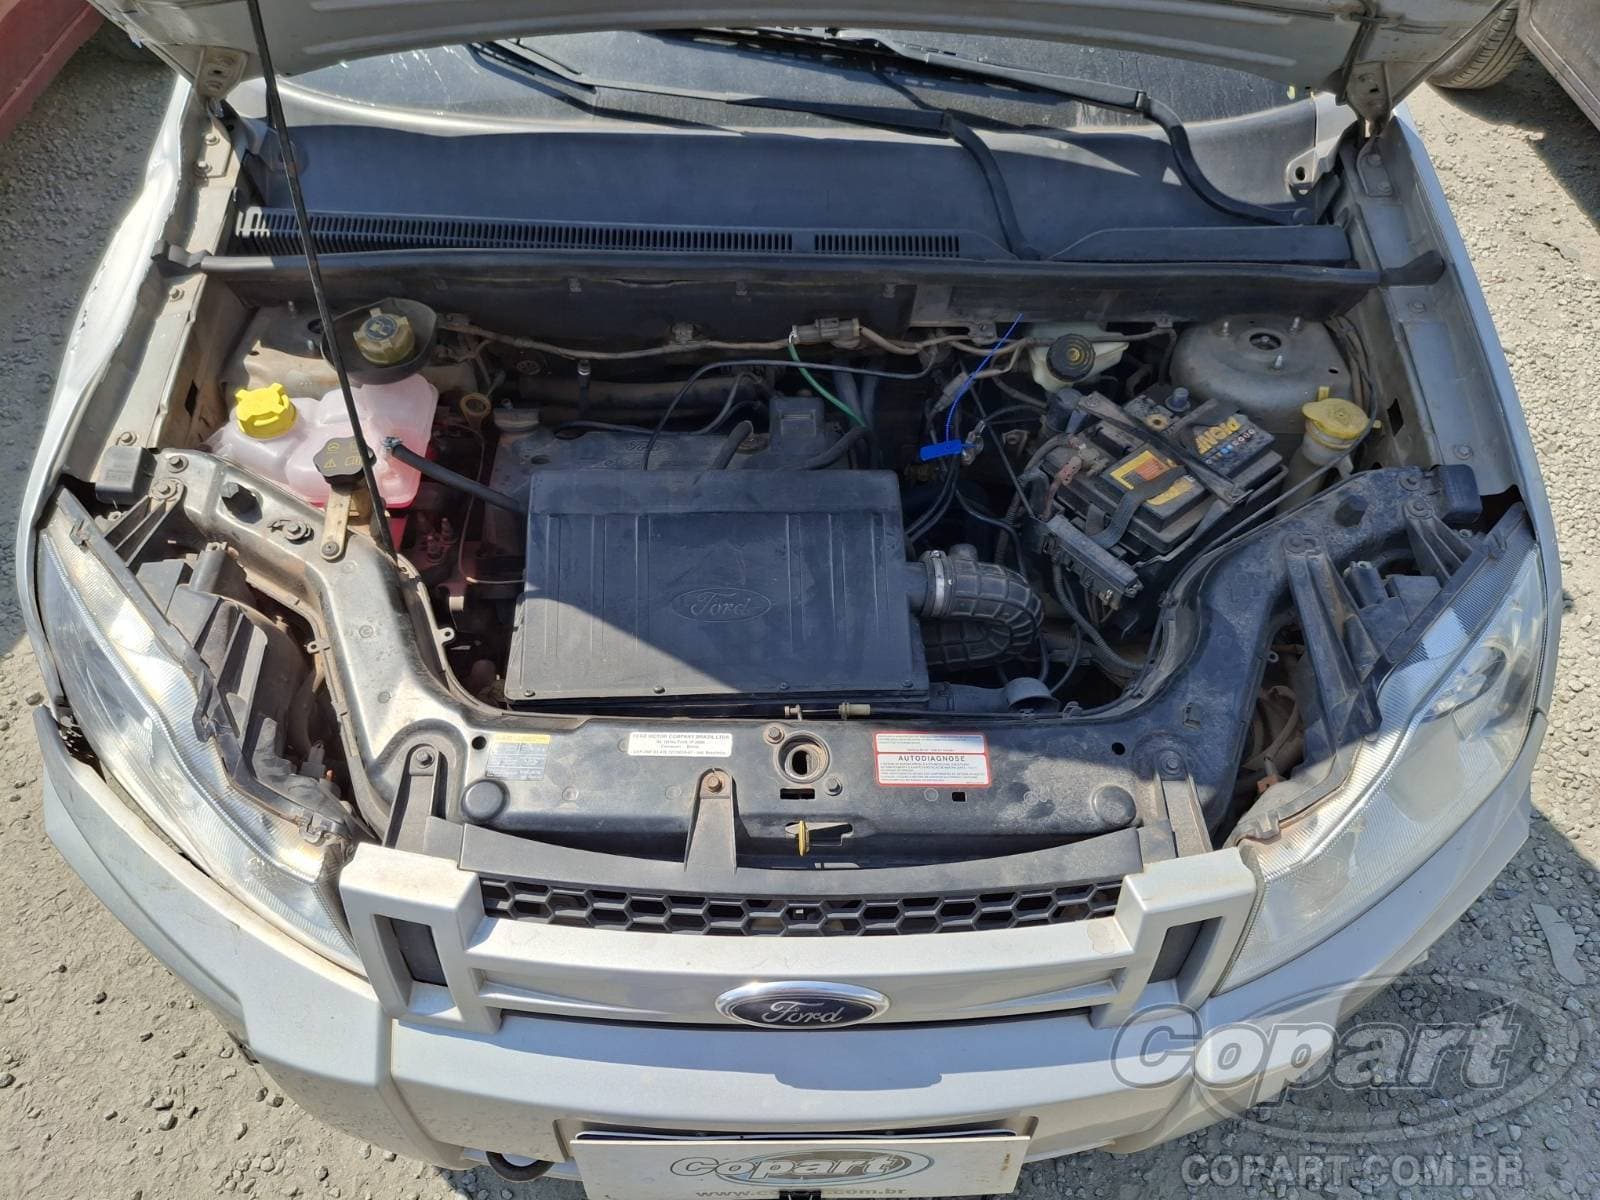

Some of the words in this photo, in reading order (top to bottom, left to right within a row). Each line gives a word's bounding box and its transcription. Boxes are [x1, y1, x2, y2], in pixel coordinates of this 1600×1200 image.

[690, 591, 752, 616] Ford
[761, 1000, 845, 1023] Ford
[670, 1154, 899, 1180] Copart
